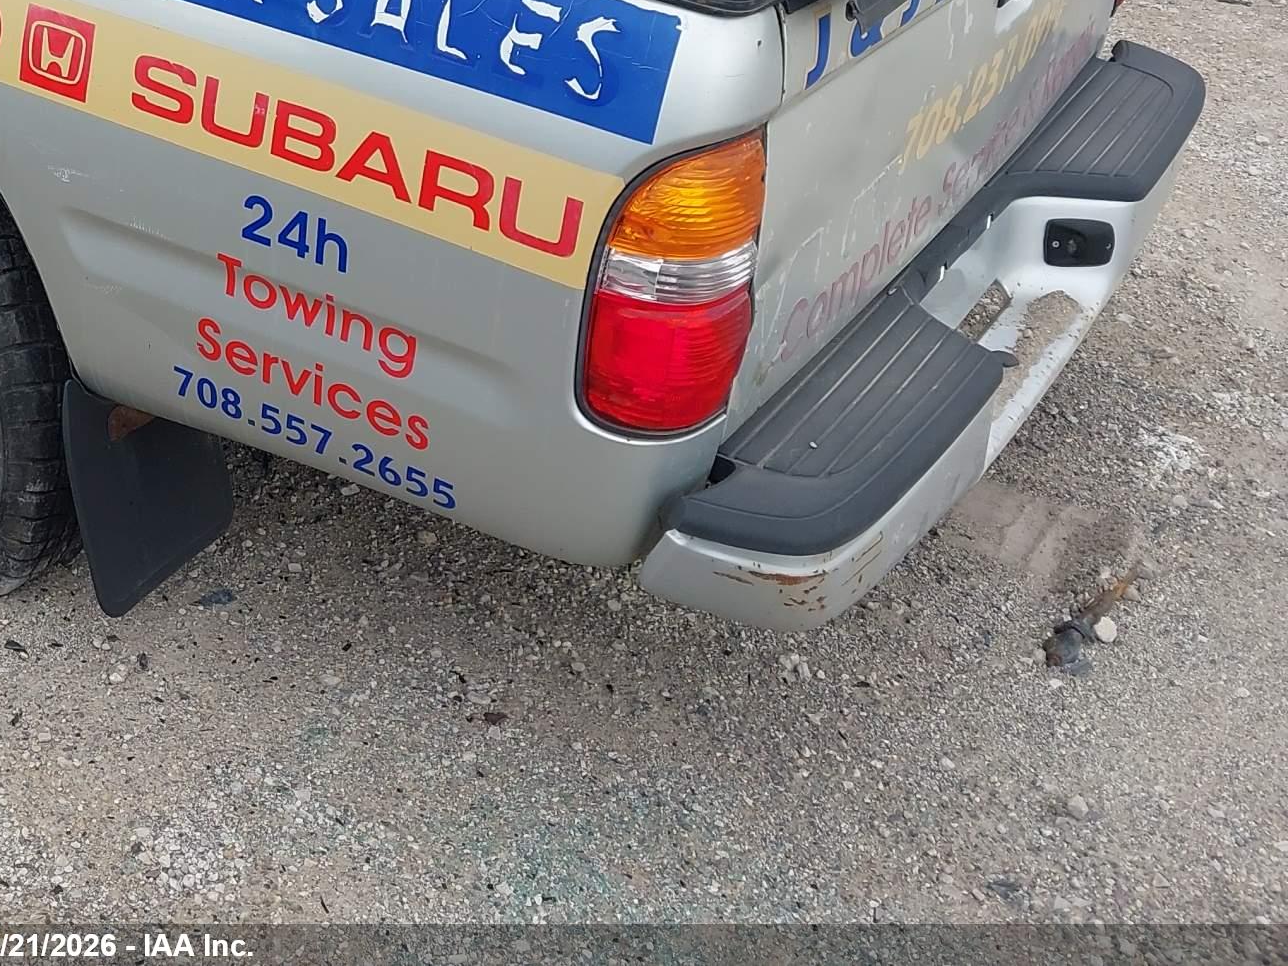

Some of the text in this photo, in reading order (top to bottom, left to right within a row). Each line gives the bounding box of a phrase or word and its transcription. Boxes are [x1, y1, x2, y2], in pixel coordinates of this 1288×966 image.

[803, 12, 832, 91] J
[130, 53, 585, 260] SUBARU
[240, 194, 349, 274] 24h
[216, 252, 418, 380] Towing
[172, 365, 458, 511] 708.557.2655
[196, 317, 431, 451] Services
